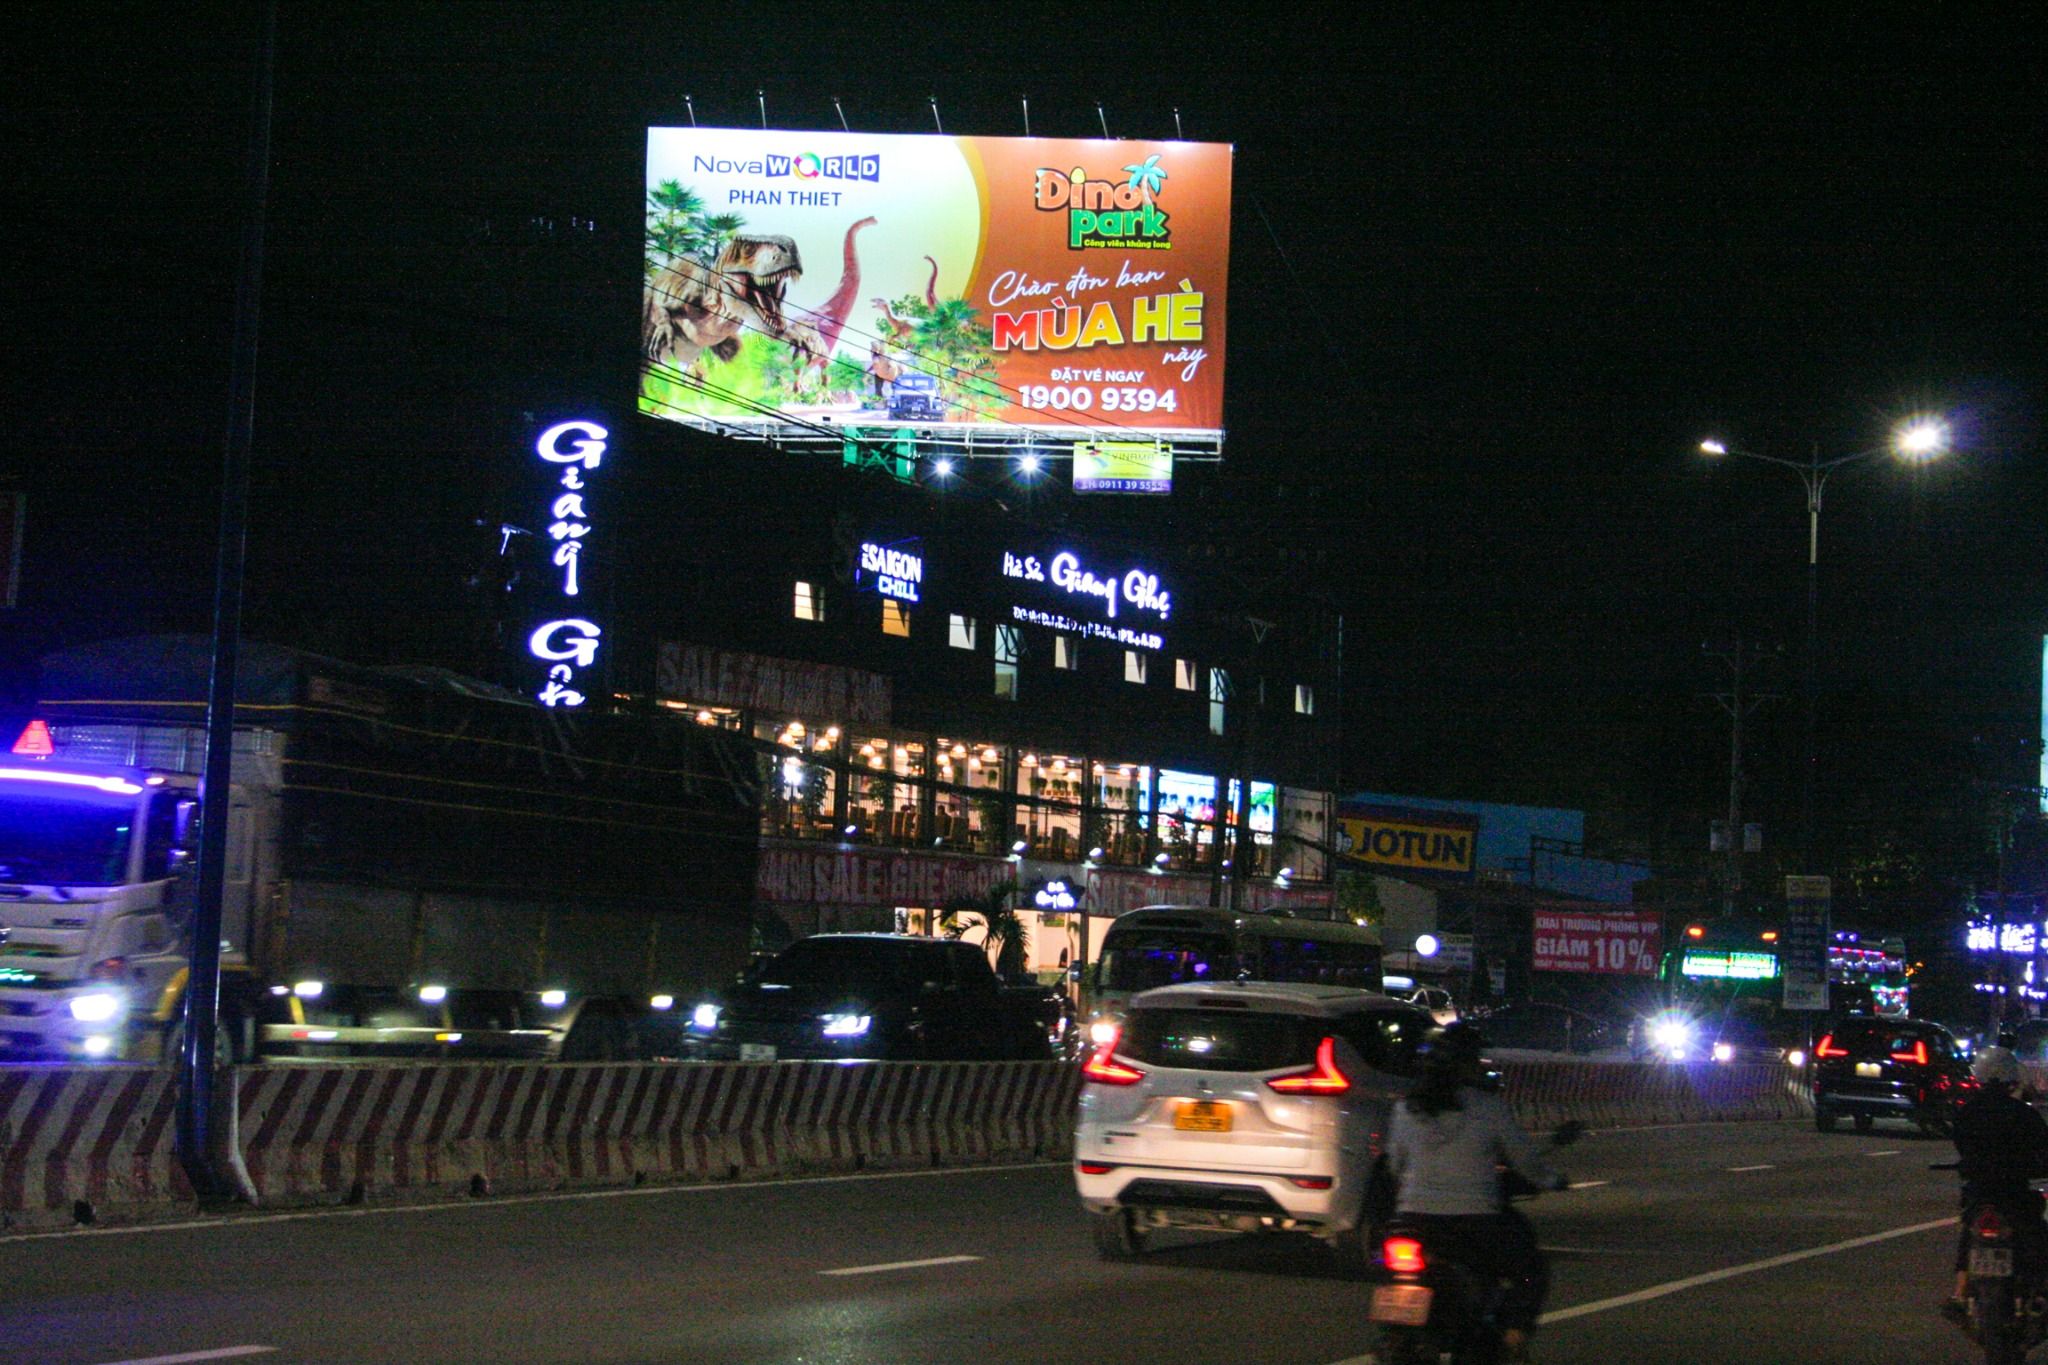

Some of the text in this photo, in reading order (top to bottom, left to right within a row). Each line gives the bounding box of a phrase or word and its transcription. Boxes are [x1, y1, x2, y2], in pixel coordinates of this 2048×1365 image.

[728, 189, 843, 207] PHAN THIET
[1035, 167, 1143, 211] Dino
[1068, 204, 1169, 249] park
[989, 270, 1059, 306] Chào
[1116, 259, 1165, 288] bạn
[992, 278, 1204, 351] MÙA HÈ
[1051, 366, 1082, 384] ĐẶT
[1105, 369, 1144, 383] NGAY
[1162, 346, 1208, 382] này
[1018, 385, 1176, 413] 1900 9394
[1099, 480, 1121, 490] 0911
[1125, 481, 1137, 490] 39
[537, 421, 609, 595] Giang
[868, 544, 922, 583] SAIGON
[878, 574, 919, 602] CHILL
[1357, 826, 1467, 865] JOTUN
[1535, 917, 1560, 930] KHAI
[1641, 922, 1659, 934] VIP
[1535, 934, 1589, 957] GIẢM
[1594, 937, 1653, 971] 10%
